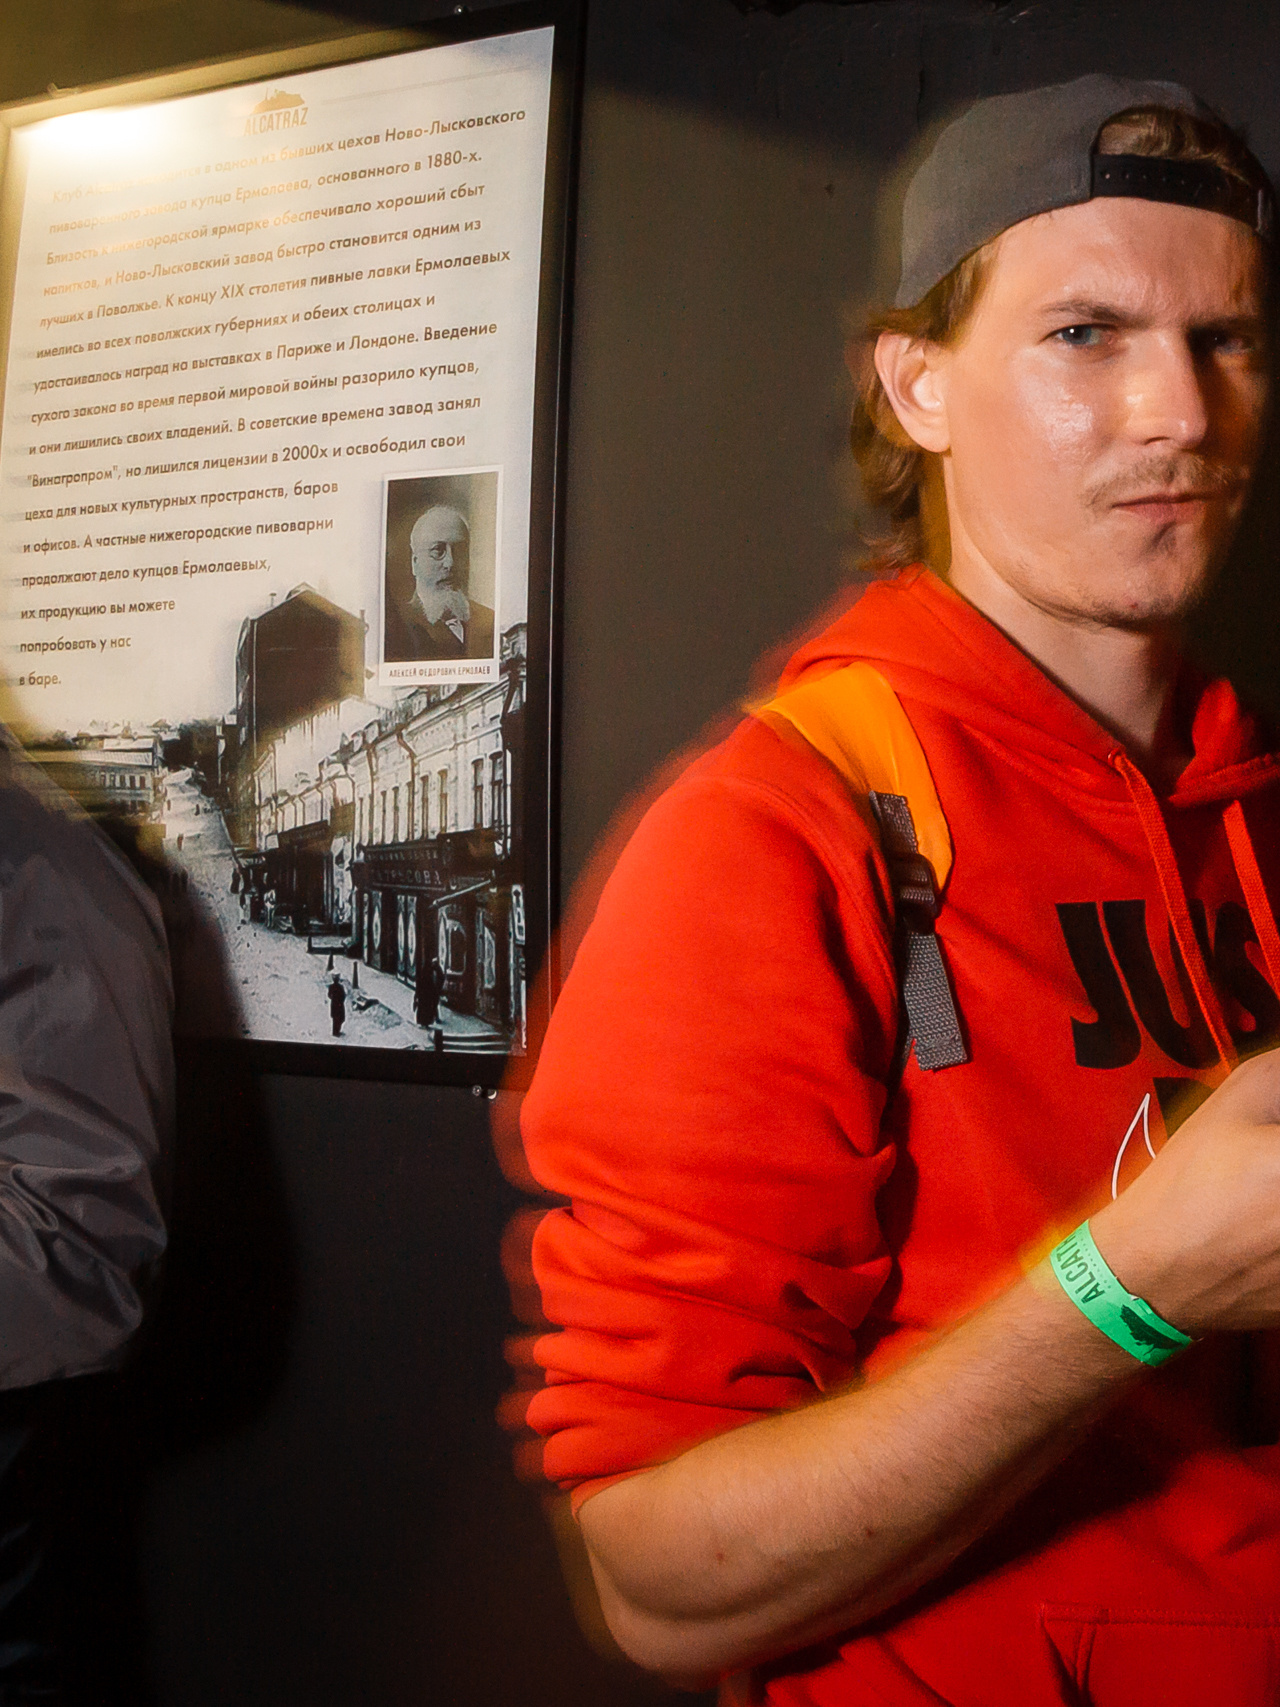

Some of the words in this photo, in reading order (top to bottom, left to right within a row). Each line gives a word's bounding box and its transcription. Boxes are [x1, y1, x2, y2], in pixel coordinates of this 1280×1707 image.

[243, 107, 309, 136] ALCATRAZ
[52, 185, 82, 204] Клуб
[204, 165, 211, 174] в
[214, 157, 258, 173] одном
[261, 153, 276, 165] из
[280, 145, 334, 161] бывших
[337, 133, 380, 150] цехов
[385, 110, 526, 143] Ново-Лысковского
[144, 200, 187, 217] завода
[191, 193, 232, 211] купца
[235, 179, 313, 204] Ермолаева,
[317, 163, 410, 186] основанного
[414, 161, 422, 172] в
[46, 249, 99, 266] Близость
[101, 247, 109, 256] к
[211, 219, 270, 239] ярмарке
[273, 201, 372, 227] обеспечивало
[375, 187, 446, 212] хороший
[450, 182, 486, 200] сбыт
[104, 276, 113, 286] и
[115, 254, 230, 284] Ново-Лысковский
[233, 251, 273, 266] завод
[277, 242, 326, 259] быстро
[329, 230, 409, 250] становится
[412, 223, 460, 240] одним
[464, 220, 482, 232] из
[39, 312, 85, 331] лучших
[87, 310, 94, 320] в
[96, 300, 162, 319] Поволжье.
[177, 291, 218, 306] концу
[248, 278, 307, 296] столетия
[310, 270, 364, 287] пивные
[367, 264, 411, 280] лавки
[415, 250, 511, 276] Ермолаевых
[35, 344, 85, 359] имелись
[87, 341, 102, 352] во
[104, 336, 132, 349] всех
[134, 324, 212, 345] поволжских
[214, 314, 288, 337] губерниях
[291, 313, 300, 323] и
[303, 304, 349, 321] обеих
[353, 297, 422, 316] столицах
[426, 295, 436, 306] и
[32, 371, 122, 395] удостаивалось
[124, 364, 169, 380] наград
[172, 361, 189, 372] на
[191, 351, 262, 370] выставках
[265, 350, 273, 361] в
[276, 342, 332, 361] Париже
[336, 341, 346, 352] и
[348, 333, 419, 351] Лондоне.
[424, 323, 498, 342] Введение
[31, 409, 71, 427] сухого
[72, 403, 117, 418] закона
[120, 401, 135, 412] во
[137, 396, 175, 413] время
[178, 386, 226, 407] первой
[228, 379, 290, 401] мировой
[293, 377, 338, 391] войны
[342, 368, 415, 391] разорило
[419, 362, 480, 381] купцов,
[28, 446, 37, 456] и
[38, 443, 62, 455] они
[63, 436, 123, 452] лишились
[126, 430, 163, 444] своих
[166, 419, 233, 440] владений.
[249, 413, 318, 431] советские
[321, 407, 384, 427] времена
[388, 402, 434, 417] завод
[437, 397, 481, 412] занял
[125, 467, 142, 478] но
[144, 460, 200, 476] лишился
[202, 453, 268, 470] лицензии
[271, 452, 279, 463] в
[332, 446, 342, 457] и
[346, 436, 426, 456] освободил
[430, 435, 466, 449] свои
[24, 509, 54, 522] цеха
[55, 506, 77, 520] для
[79, 502, 118, 516] новых
[121, 495, 197, 515] культурных
[200, 487, 288, 508] пространств,
[293, 480, 339, 499] баров
[23, 544, 31, 554] и
[33, 538, 80, 556] офисов.
[95, 534, 147, 547] частные
[149, 525, 252, 544] нижегородские
[256, 519, 334, 535] пивоварни
[22, 571, 98, 590] продолжают
[99, 569, 130, 583] дело
[132, 565, 179, 582] купцов
[182, 559, 271, 579] Ермолаевых,
[20, 609, 37, 620] их
[38, 604, 107, 622] продукцию
[110, 603, 126, 614] вы
[128, 600, 176, 613] можете
[20, 636, 97, 656] попробовать
[110, 637, 132, 648] нас
[19, 675, 26, 687] в
[27, 670, 62, 689] баре.
[389, 667, 417, 678] АЛЕКСЕЙ
[418, 666, 456, 677] ФЕДОРОВИЧ
[457, 665, 491, 676] ЕРМОЛАЕВ
